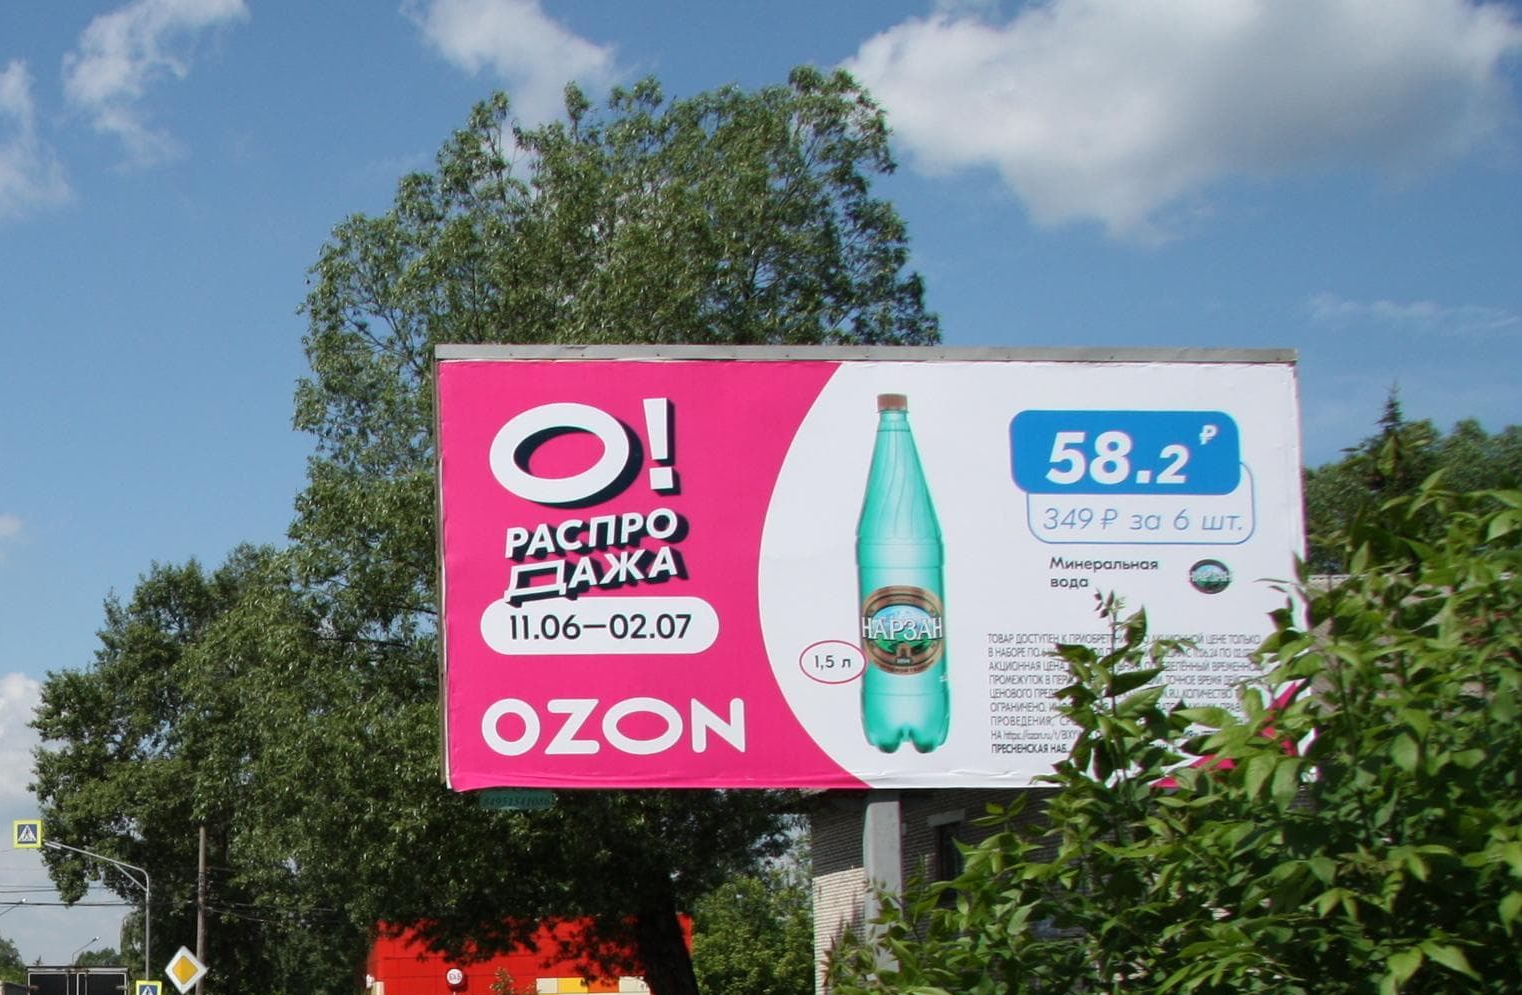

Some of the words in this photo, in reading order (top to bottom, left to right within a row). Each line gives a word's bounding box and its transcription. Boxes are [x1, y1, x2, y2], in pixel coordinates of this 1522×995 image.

[1045, 430, 1191, 485] 58.2
[1043, 507, 1094, 530] 349
[1129, 514, 1162, 531] за
[1173, 508, 1191, 531] 6
[1201, 514, 1243, 532] шт.
[505, 508, 681, 559] РАСПРО
[1049, 557, 1159, 573] Минеральная
[504, 546, 681, 606] ДАЖА
[1050, 576, 1089, 589] вода
[861, 615, 943, 641] НАРЗАН
[988, 633, 1014, 644] ТОВАР
[1016, 633, 1059, 645] ДОСТУПЕН
[995, 647, 1026, 658] НАБОРЕ
[814, 655, 835, 671] 1,5
[841, 657, 852, 668] л
[989, 660, 1041, 671] АКЦИОННАЯ
[989, 674, 1043, 685] ПРОМЕЖУТОК
[990, 688, 1032, 699] ЦЕНОВОГО
[481, 697, 746, 756] OZON
[991, 743, 1049, 754] ПРЕСНЕНСКАЯ
